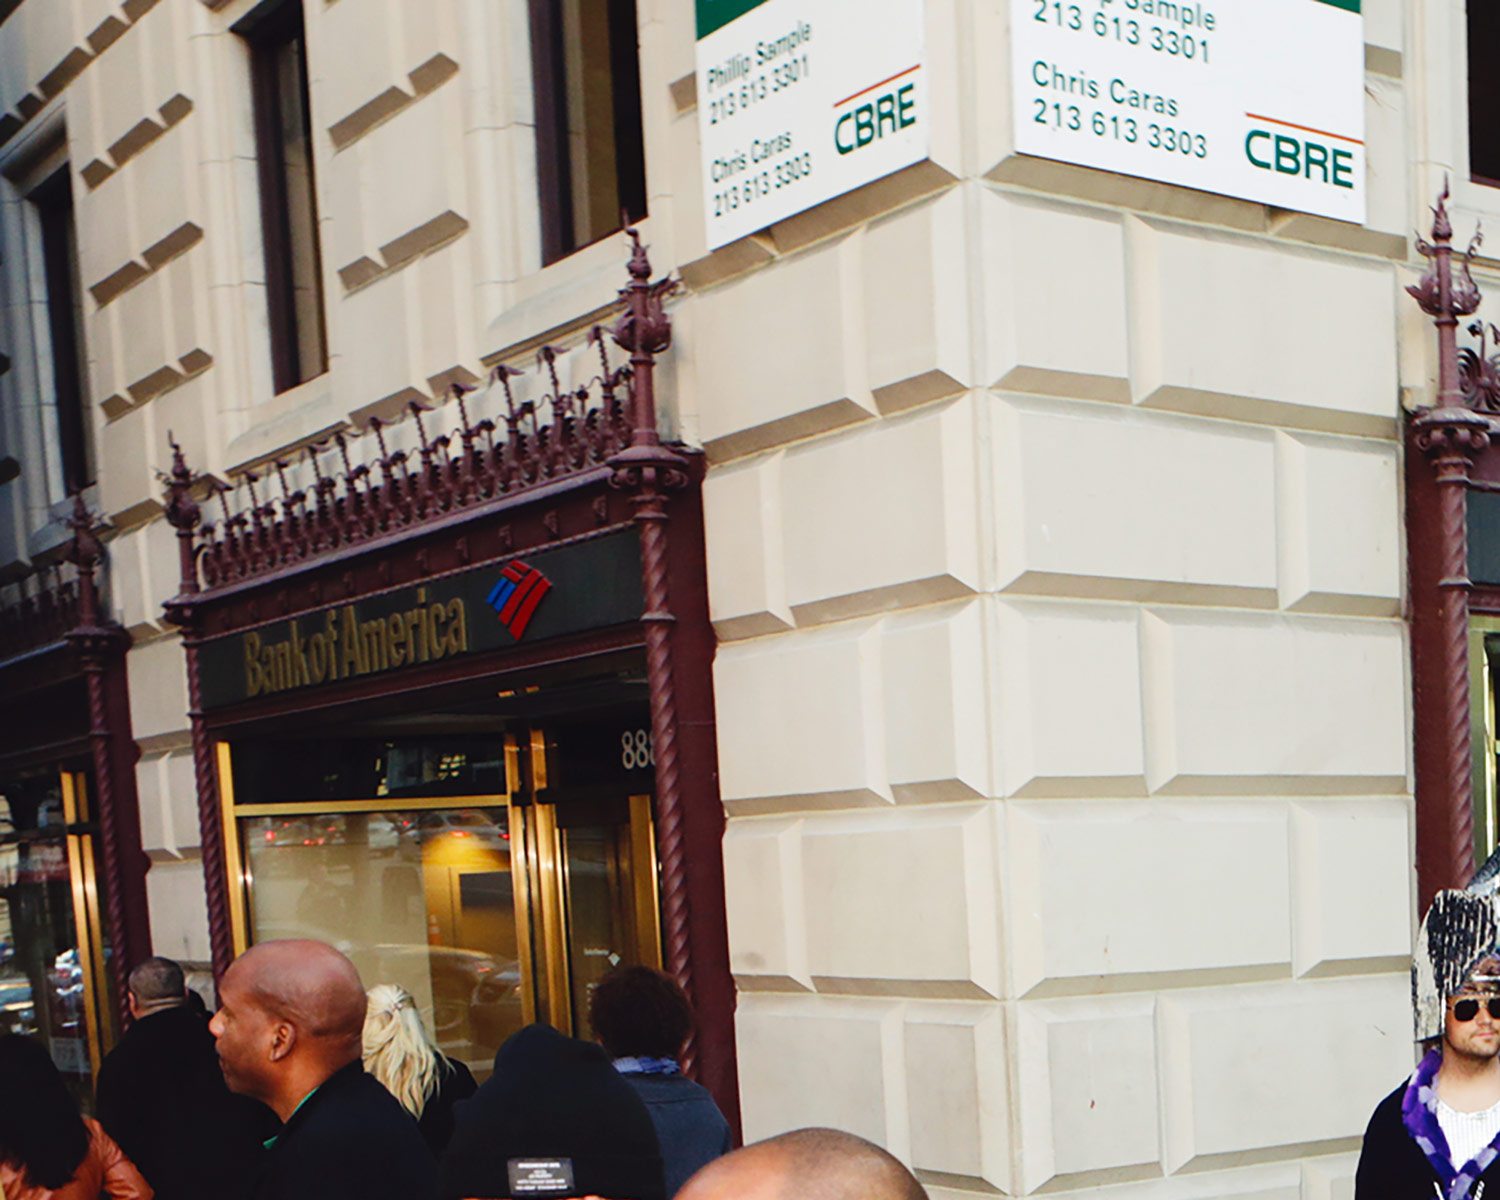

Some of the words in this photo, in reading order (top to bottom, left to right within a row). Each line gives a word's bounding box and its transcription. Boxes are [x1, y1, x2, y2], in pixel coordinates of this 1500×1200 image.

[707, 52, 750, 93] Phillip
[756, 20, 811, 65] Sample
[1033, 0, 1082, 31] 213
[1093, 11, 1140, 45] 613
[1150, 26, 1209, 63] 3301
[710, 92, 736, 125] 213
[740, 75, 767, 108] 613
[772, 54, 809, 92] 3301
[834, 82, 916, 156] CBRE
[1033, 60, 1099, 100] Chris
[1109, 78, 1179, 118] Caras
[711, 150, 748, 183] Chris
[751, 131, 793, 164] Caras
[1033, 98, 1082, 131] 213
[1092, 111, 1138, 144] 613
[1148, 123, 1207, 159] 3303
[1244, 129, 1355, 190] CBRE
[714, 185, 741, 217] 213
[743, 170, 770, 204] 613
[775, 151, 812, 189] 3303
[244, 619, 312, 698] Bank
[309, 608, 339, 682] of
[341, 587, 469, 678] America
